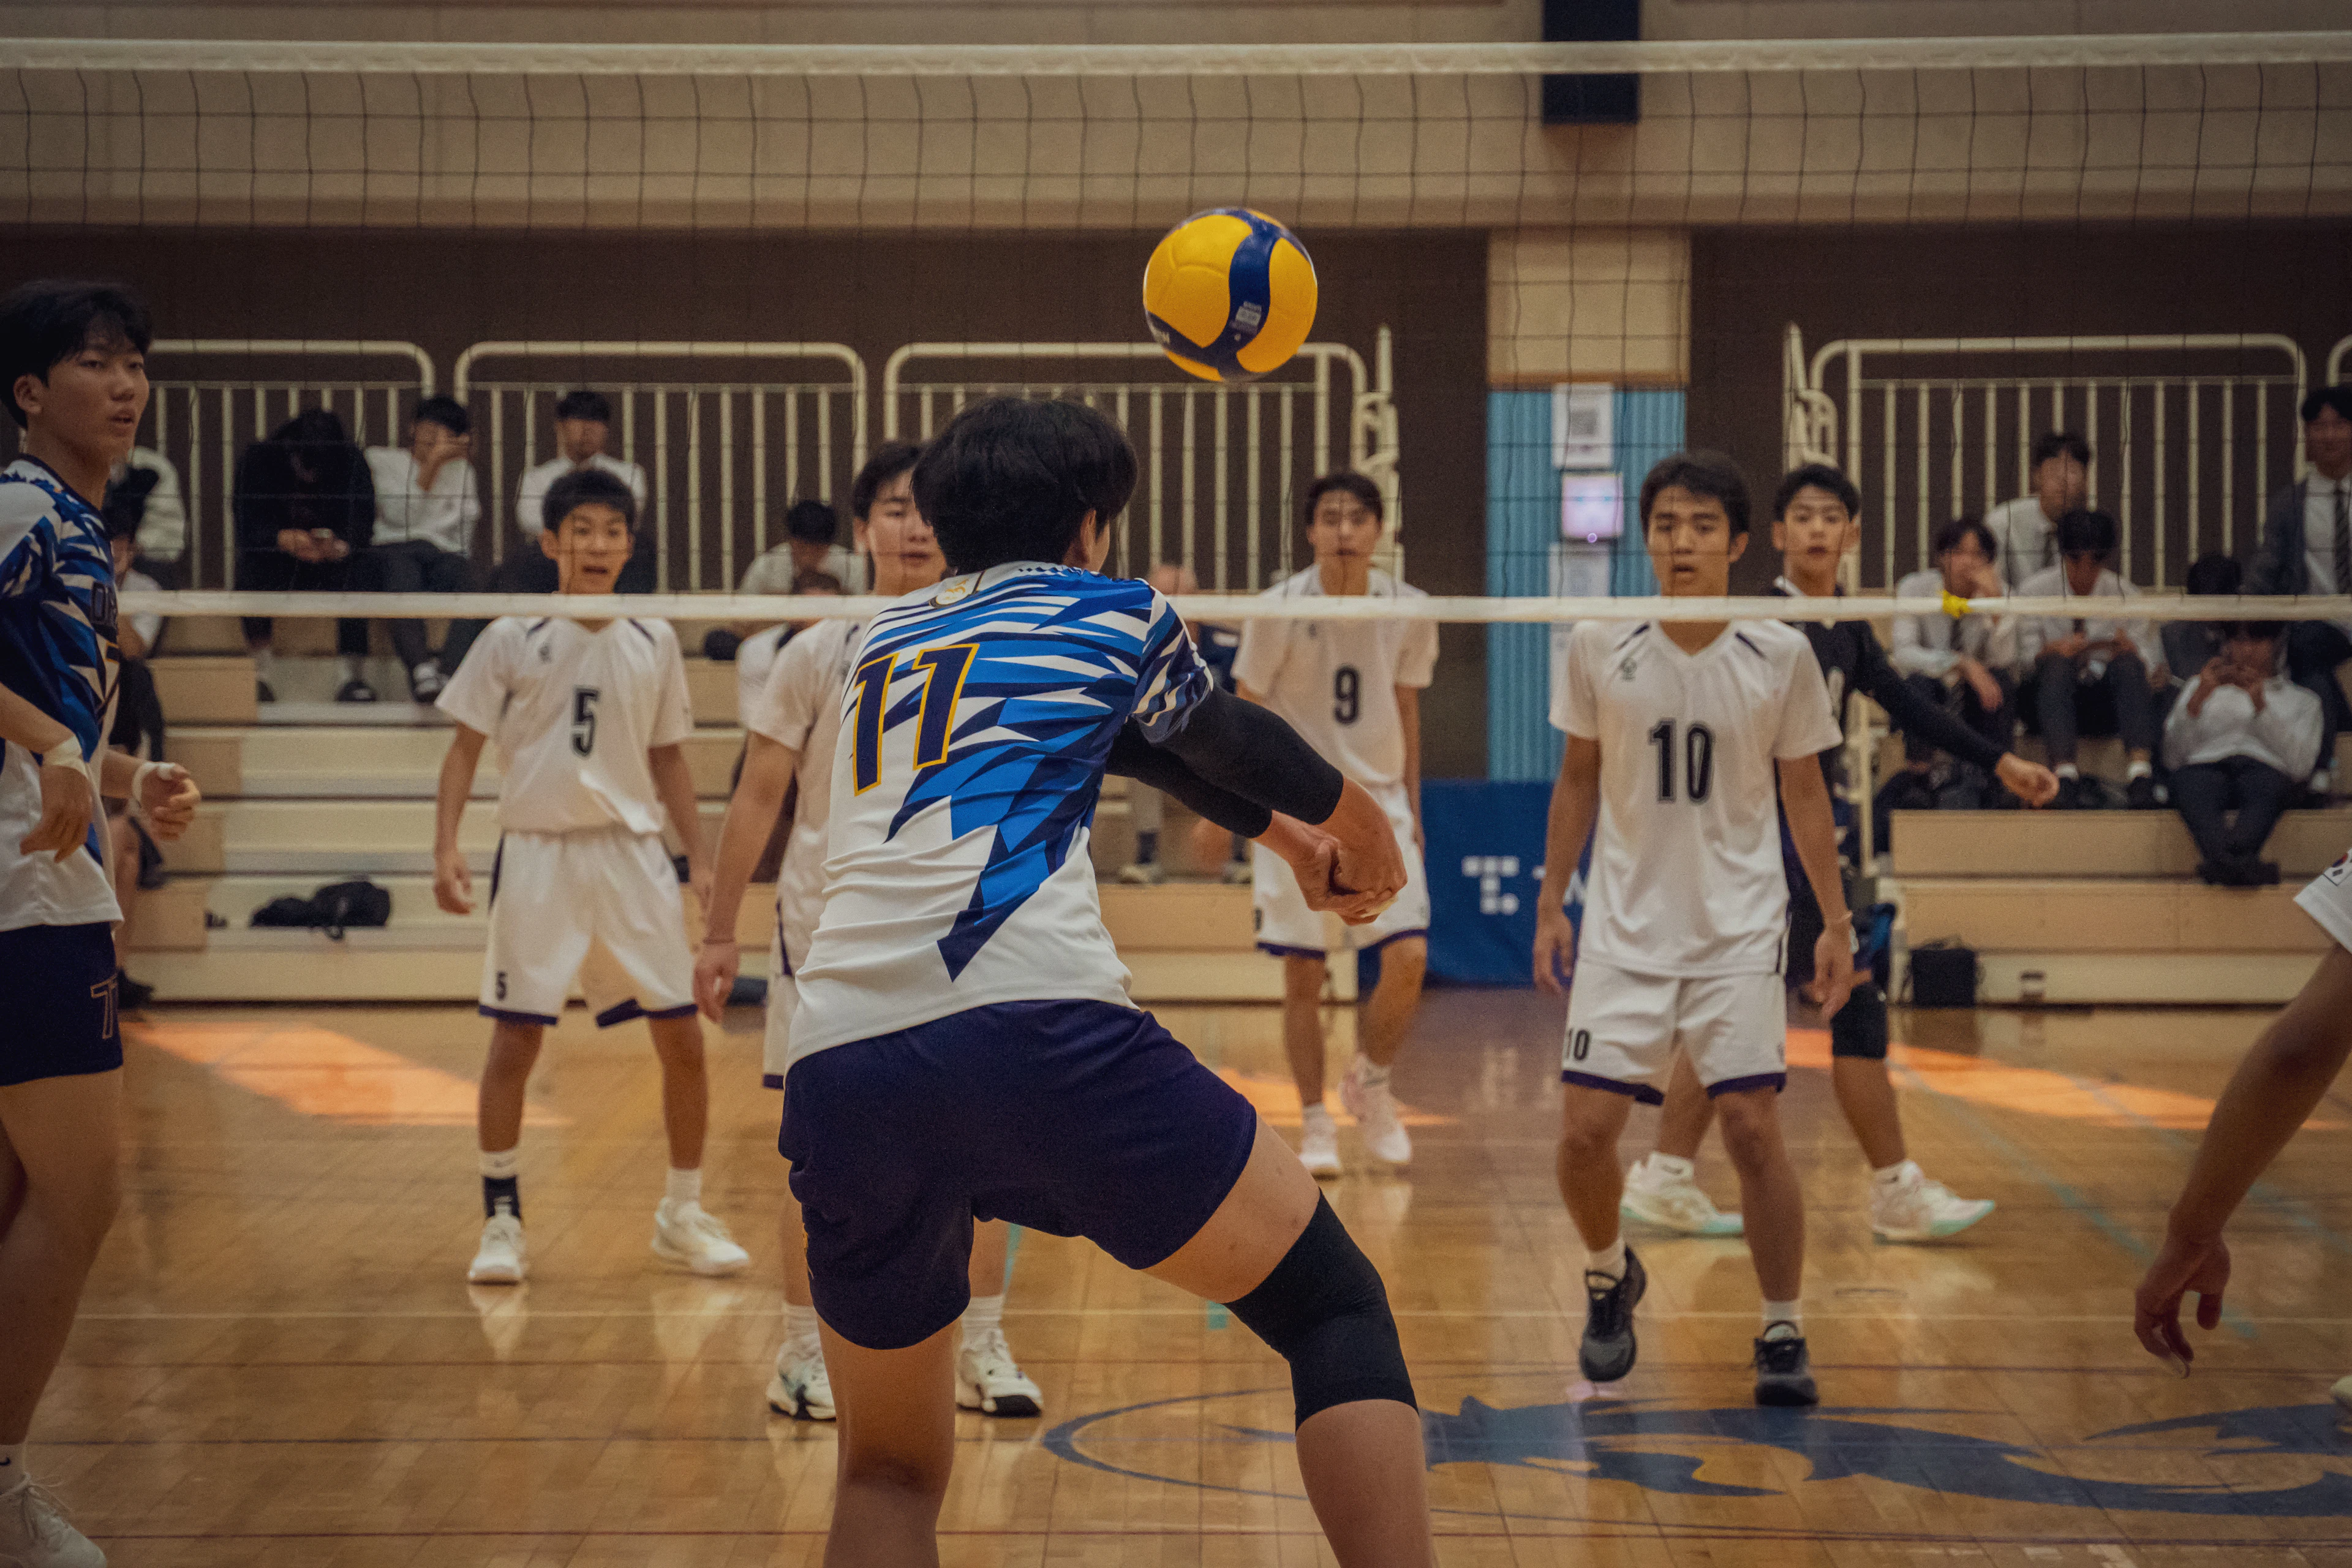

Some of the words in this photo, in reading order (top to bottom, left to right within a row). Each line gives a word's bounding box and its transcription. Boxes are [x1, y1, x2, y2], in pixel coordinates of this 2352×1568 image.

[572, 685, 600, 758] 5
[852, 643, 980, 797] 11
[1333, 664, 1361, 726] 9
[1648, 717, 1714, 805] 10
[495, 971, 508, 1001] 5
